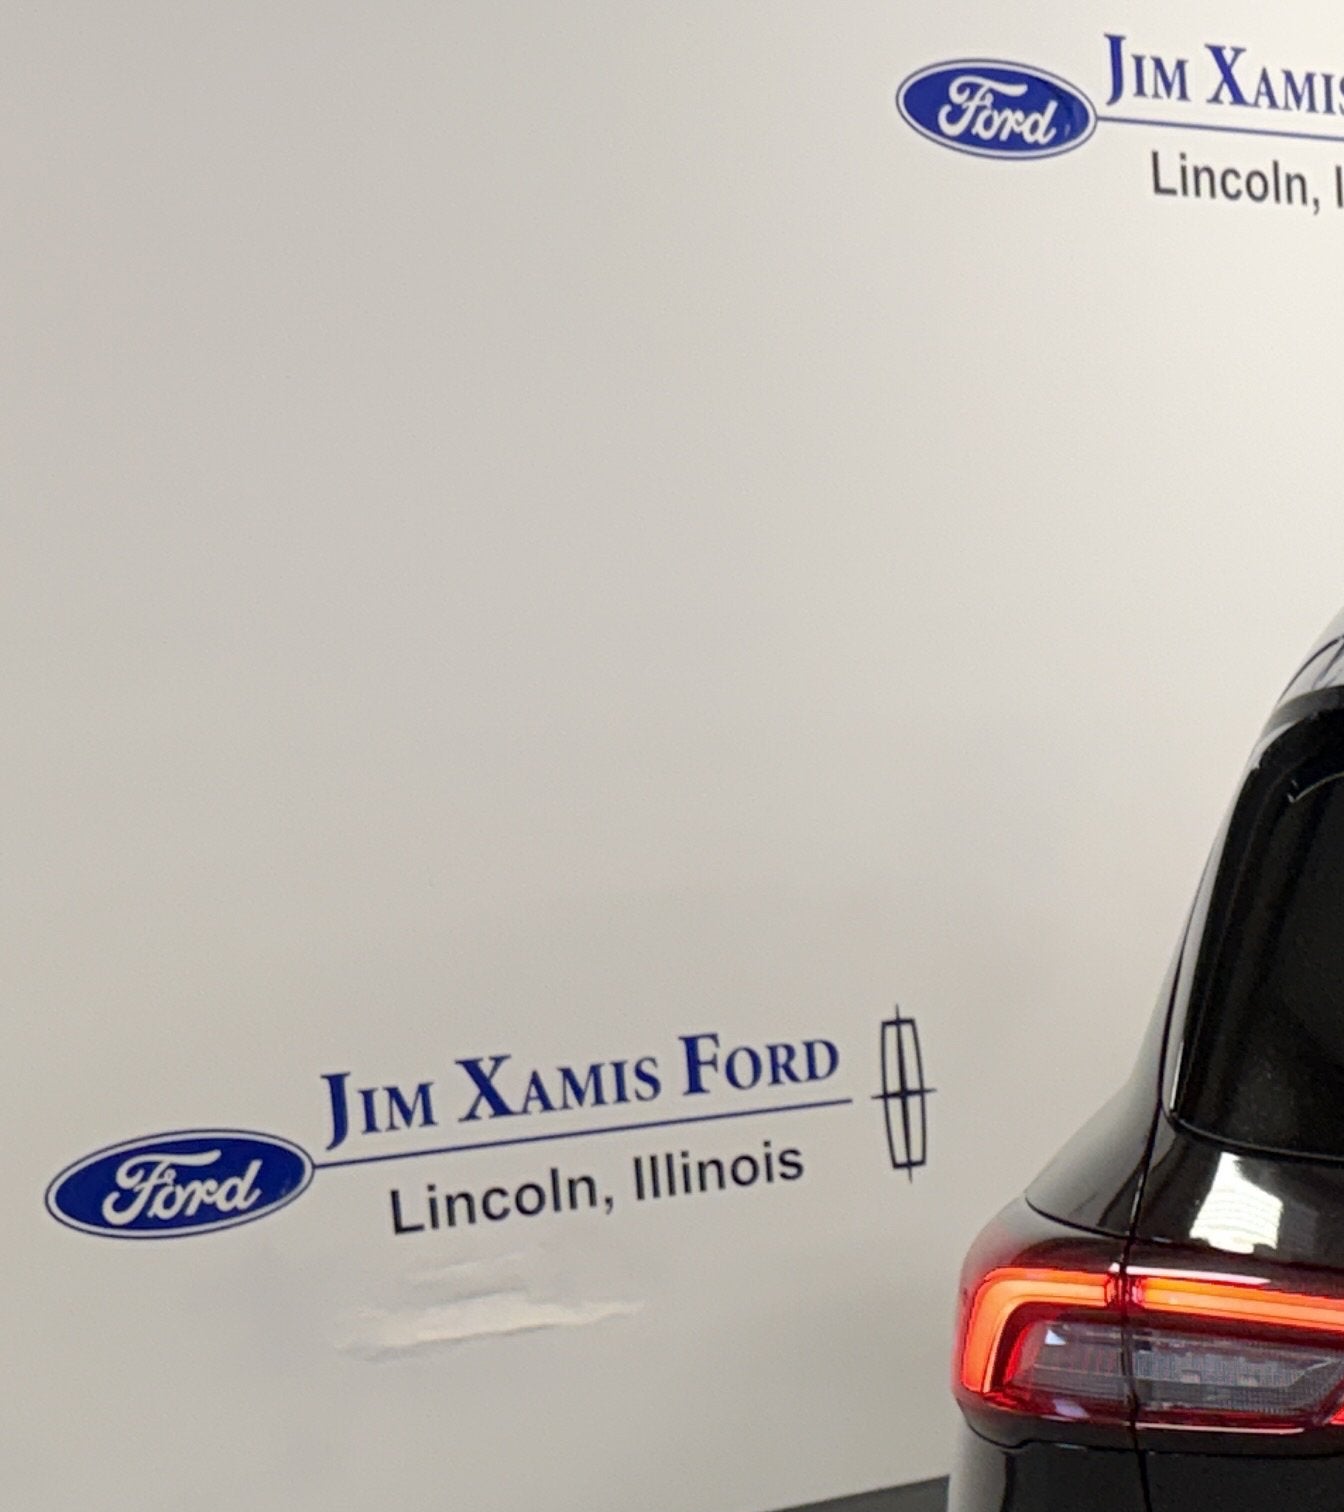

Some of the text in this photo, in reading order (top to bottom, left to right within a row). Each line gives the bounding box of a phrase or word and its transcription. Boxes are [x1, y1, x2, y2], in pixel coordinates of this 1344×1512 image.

[1103, 33, 1191, 106] JIM
[938, 75, 1058, 145] Ford
[1151, 150, 1320, 216] Lincoln,
[319, 1030, 840, 1151] JIM XAMIS FORD
[101, 1150, 262, 1225] Ford
[389, 1139, 805, 1237] Lincoln, Illinois
